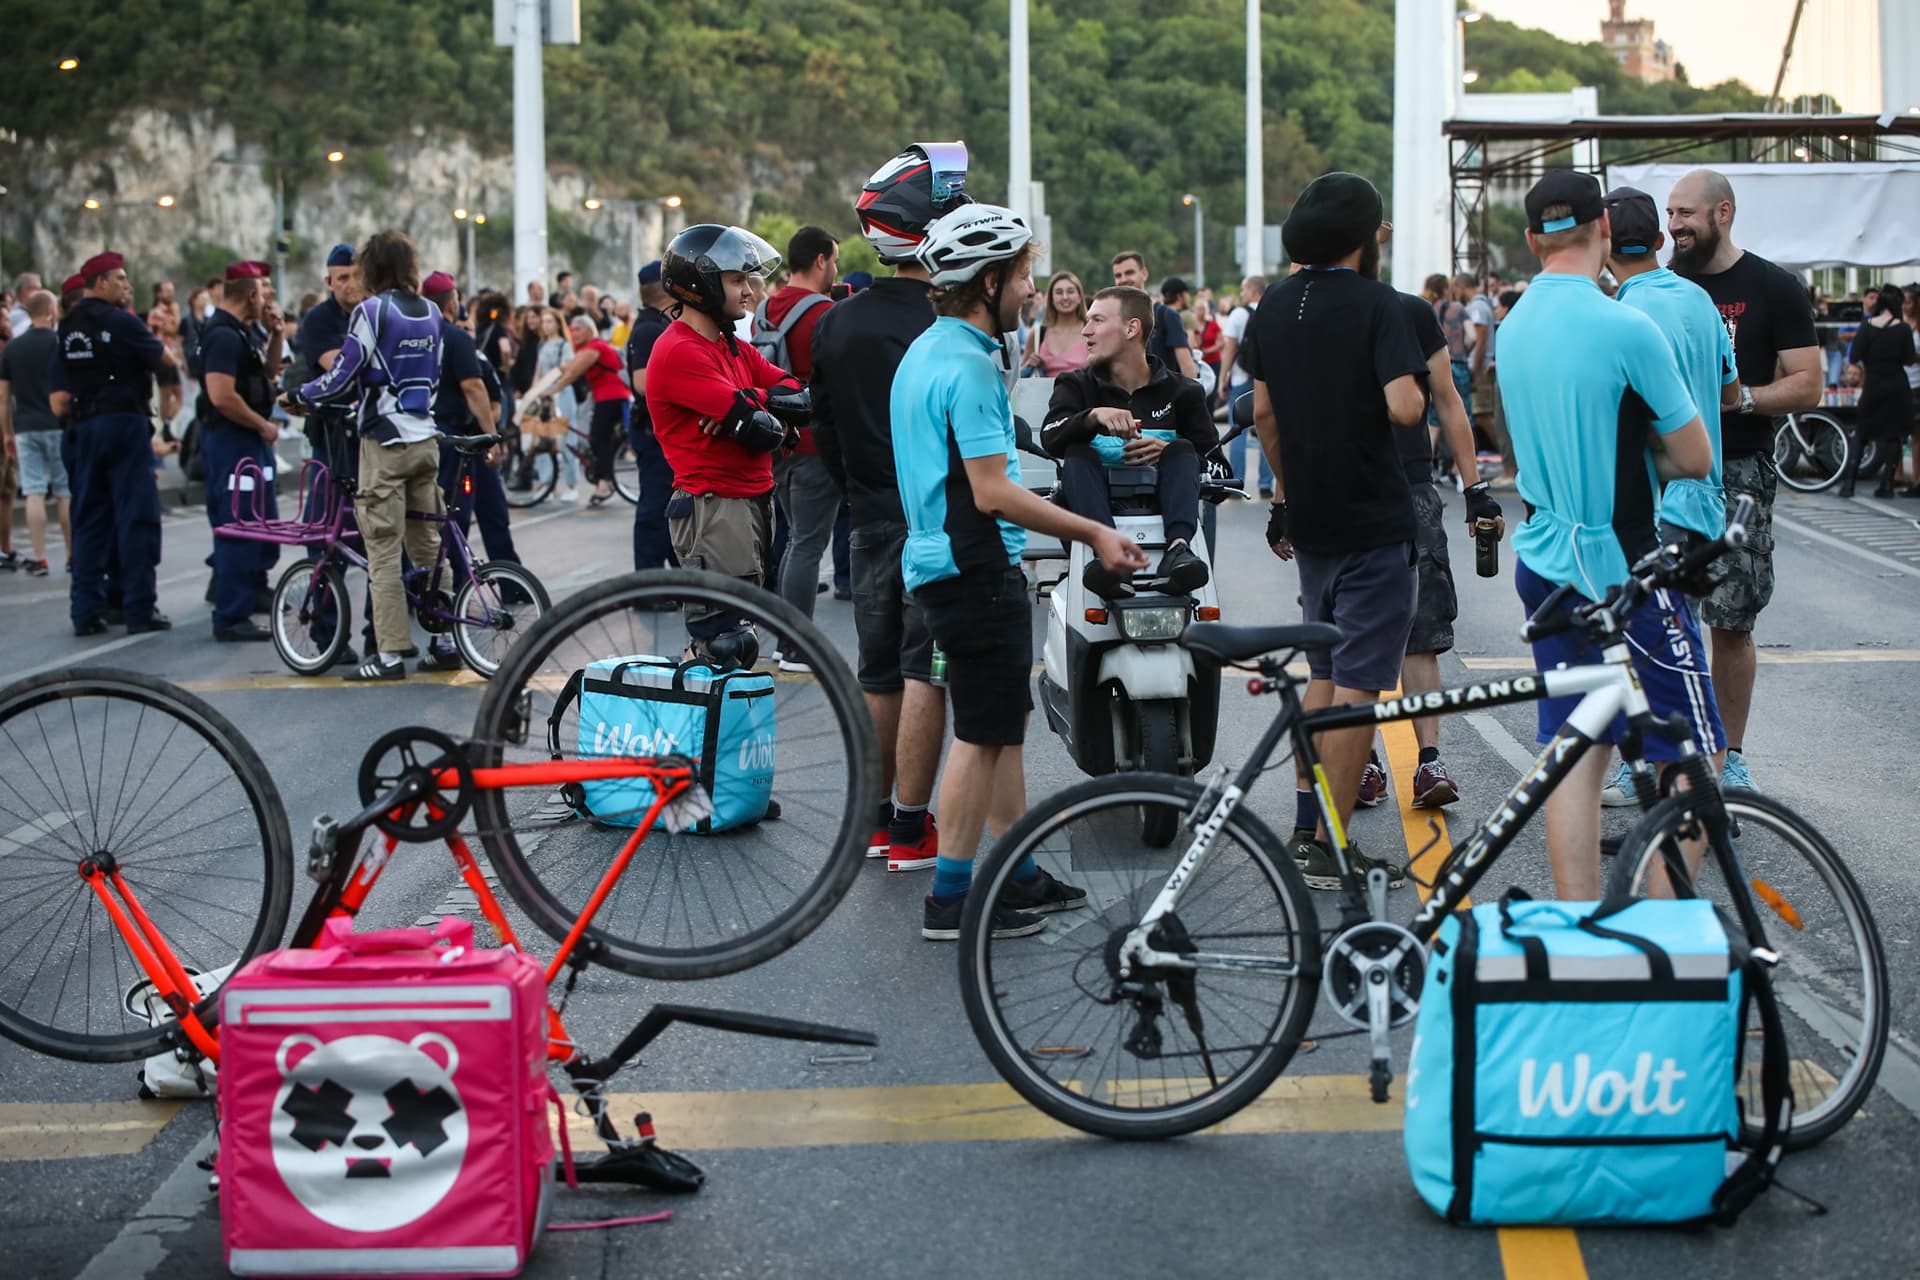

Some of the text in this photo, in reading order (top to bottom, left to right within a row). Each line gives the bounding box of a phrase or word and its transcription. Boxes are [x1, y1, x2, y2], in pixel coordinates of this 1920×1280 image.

[1373, 676, 1535, 719] MUSTANG
[1167, 797, 1235, 890] WICHITA
[1415, 734, 1579, 922] WICHITA
[1518, 1052, 1687, 1118] Wolt
